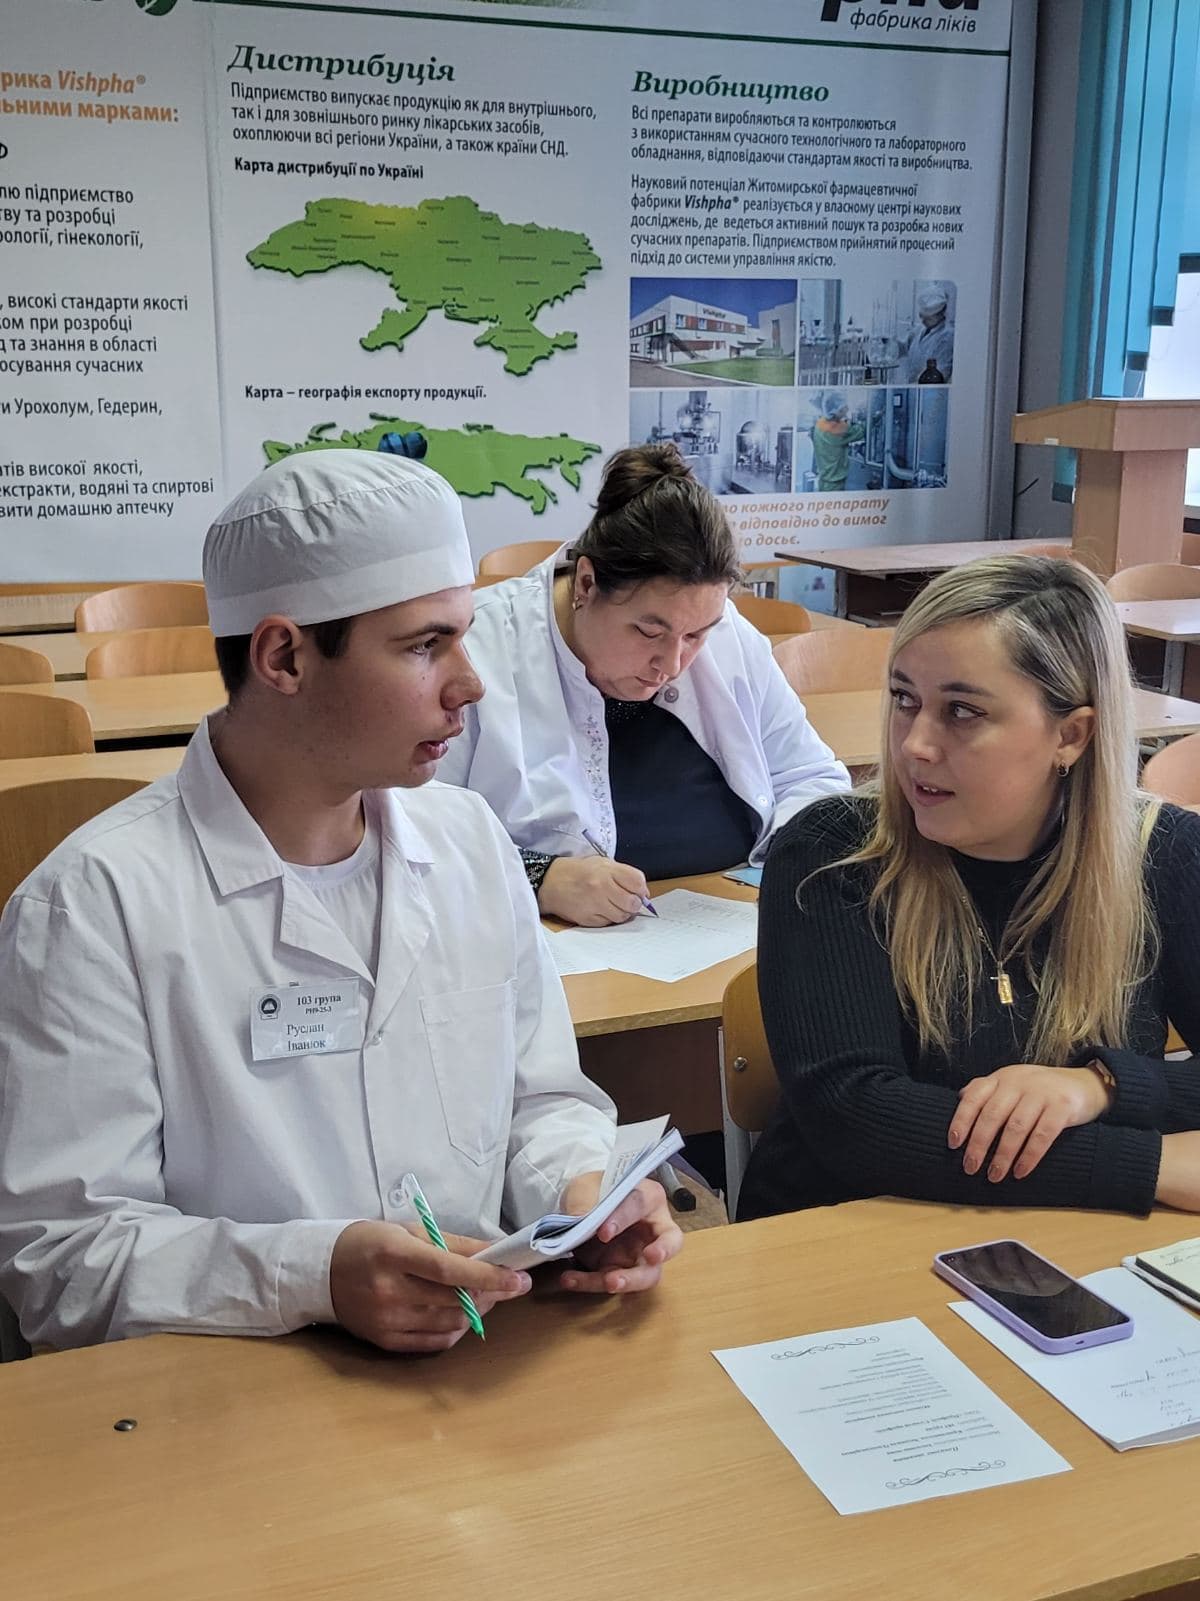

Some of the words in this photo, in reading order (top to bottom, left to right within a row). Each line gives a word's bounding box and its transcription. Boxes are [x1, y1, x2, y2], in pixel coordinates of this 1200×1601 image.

[850, 7, 932, 32] фабрика
[935, 14, 976, 33] ліків
[226, 45, 455, 85] Дистрибуція
[632, 71, 829, 104] Виробництво
[231, 81, 328, 103] Підприємство
[331, 91, 390, 108] випускає
[393, 95, 461, 113] продукцію
[464, 99, 480, 112] як
[482, 100, 505, 115] для
[508, 101, 596, 120] внутрішнього,
[78, 102, 179, 122] марками:
[231, 107, 254, 119] так
[258, 106, 261, 120] і
[264, 108, 290, 123] для
[293, 109, 379, 126] зовнішнього
[382, 115, 421, 132] ринку
[423, 114, 493, 134] лікарських
[495, 119, 544, 137] засобів,
[632, 104, 648, 120] Всі
[651, 109, 712, 125] препарати
[715, 110, 795, 127] виробляються
[798, 116, 809, 127] та
[812, 117, 896, 132] контролюються
[233, 127, 312, 143] охоплюючи
[315, 130, 333, 144] всі
[336, 133, 385, 148] регіони
[388, 132, 442, 152] України,
[446, 138, 453, 150] а
[455, 139, 494, 152] також
[497, 139, 537, 156] країни
[540, 140, 569, 158] СНД.
[631, 127, 638, 139] з
[641, 128, 731, 144] використанням
[733, 132, 789, 147] сучасного
[791, 134, 872, 148] технологічного
[874, 138, 886, 149] та
[888, 135, 966, 154] лабораторного
[631, 145, 705, 162] обладнання,
[708, 147, 785, 165] відповідаючи
[787, 153, 851, 168] стандартам
[853, 153, 886, 167] якості
[888, 157, 899, 167] та
[901, 154, 973, 171] виробництва.
[234, 157, 274, 175] Карта
[277, 161, 357, 178] дистрибуції
[360, 166, 375, 176] по
[377, 163, 424, 181] Україні
[25, 183, 134, 205] підприємство
[631, 174, 687, 192] Науковий
[690, 177, 746, 193] потенціал
[747, 178, 828, 196] Житомирської
[829, 180, 918, 197] фармацевтичної
[631, 193, 681, 211] фабрики
[743, 197, 813, 215] реалізується
[815, 202, 822, 216] у
[824, 201, 875, 217] власному
[877, 201, 911, 217] центрі
[913, 204, 962, 218] наукових
[24, 209, 41, 222] та
[46, 207, 115, 227] розробці
[631, 214, 702, 230] досліджень,
[704, 217, 718, 230] де
[724, 217, 774, 231] ведеться
[776, 218, 828, 230] активний
[832, 220, 865, 234] пошук
[867, 221, 879, 231] та
[881, 218, 930, 235] розробка
[932, 222, 964, 233] нових
[58, 232, 143, 249] гінекології,
[631, 234, 682, 248] сучасних
[684, 234, 750, 250] препаратів.
[753, 234, 838, 251] Підприємством
[840, 236, 898, 252] прийнятий
[900, 237, 955, 253] процесний
[631, 251, 665, 266] підхід
[667, 253, 682, 266] до
[684, 253, 731, 265] системи
[733, 252, 795, 268] управління
[797, 253, 836, 266] якістю.
[8, 293, 57, 309] високі
[61, 296, 139, 313] стандарти
[143, 295, 188, 311] якості
[30, 317, 59, 334] при
[64, 314, 132, 334] розробці
[9, 339, 26, 351] та
[30, 339, 85, 351] знання
[90, 339, 99, 351] в
[102, 336, 157, 352] області
[76, 360, 144, 376] сучасних
[245, 385, 283, 401] Карта
[298, 385, 362, 401] географія
[365, 388, 421, 401] експорту
[424, 385, 487, 401] продукції.
[14, 398, 94, 418] Урохолум,
[98, 398, 162, 417] Гедерин,
[29, 460, 86, 476] високої
[93, 459, 142, 476] якості,
[79, 480, 129, 497] водяні
[132, 482, 148, 494] та
[152, 478, 214, 497] спиртові
[37, 503, 113, 520] домашню
[116, 502, 174, 517] аптечку
[741, 502, 804, 513] кожного
[807, 498, 891, 514] препарату
[739, 515, 820, 530] відповідно
[822, 514, 840, 527] до
[843, 515, 887, 526] вимог
[756, 534, 800, 546] досьє.
[297, 996, 312, 1005] 103
[314, 995, 342, 1007] група
[287, 1024, 324, 1037] Руслан
[288, 1040, 326, 1052] Іванюк
